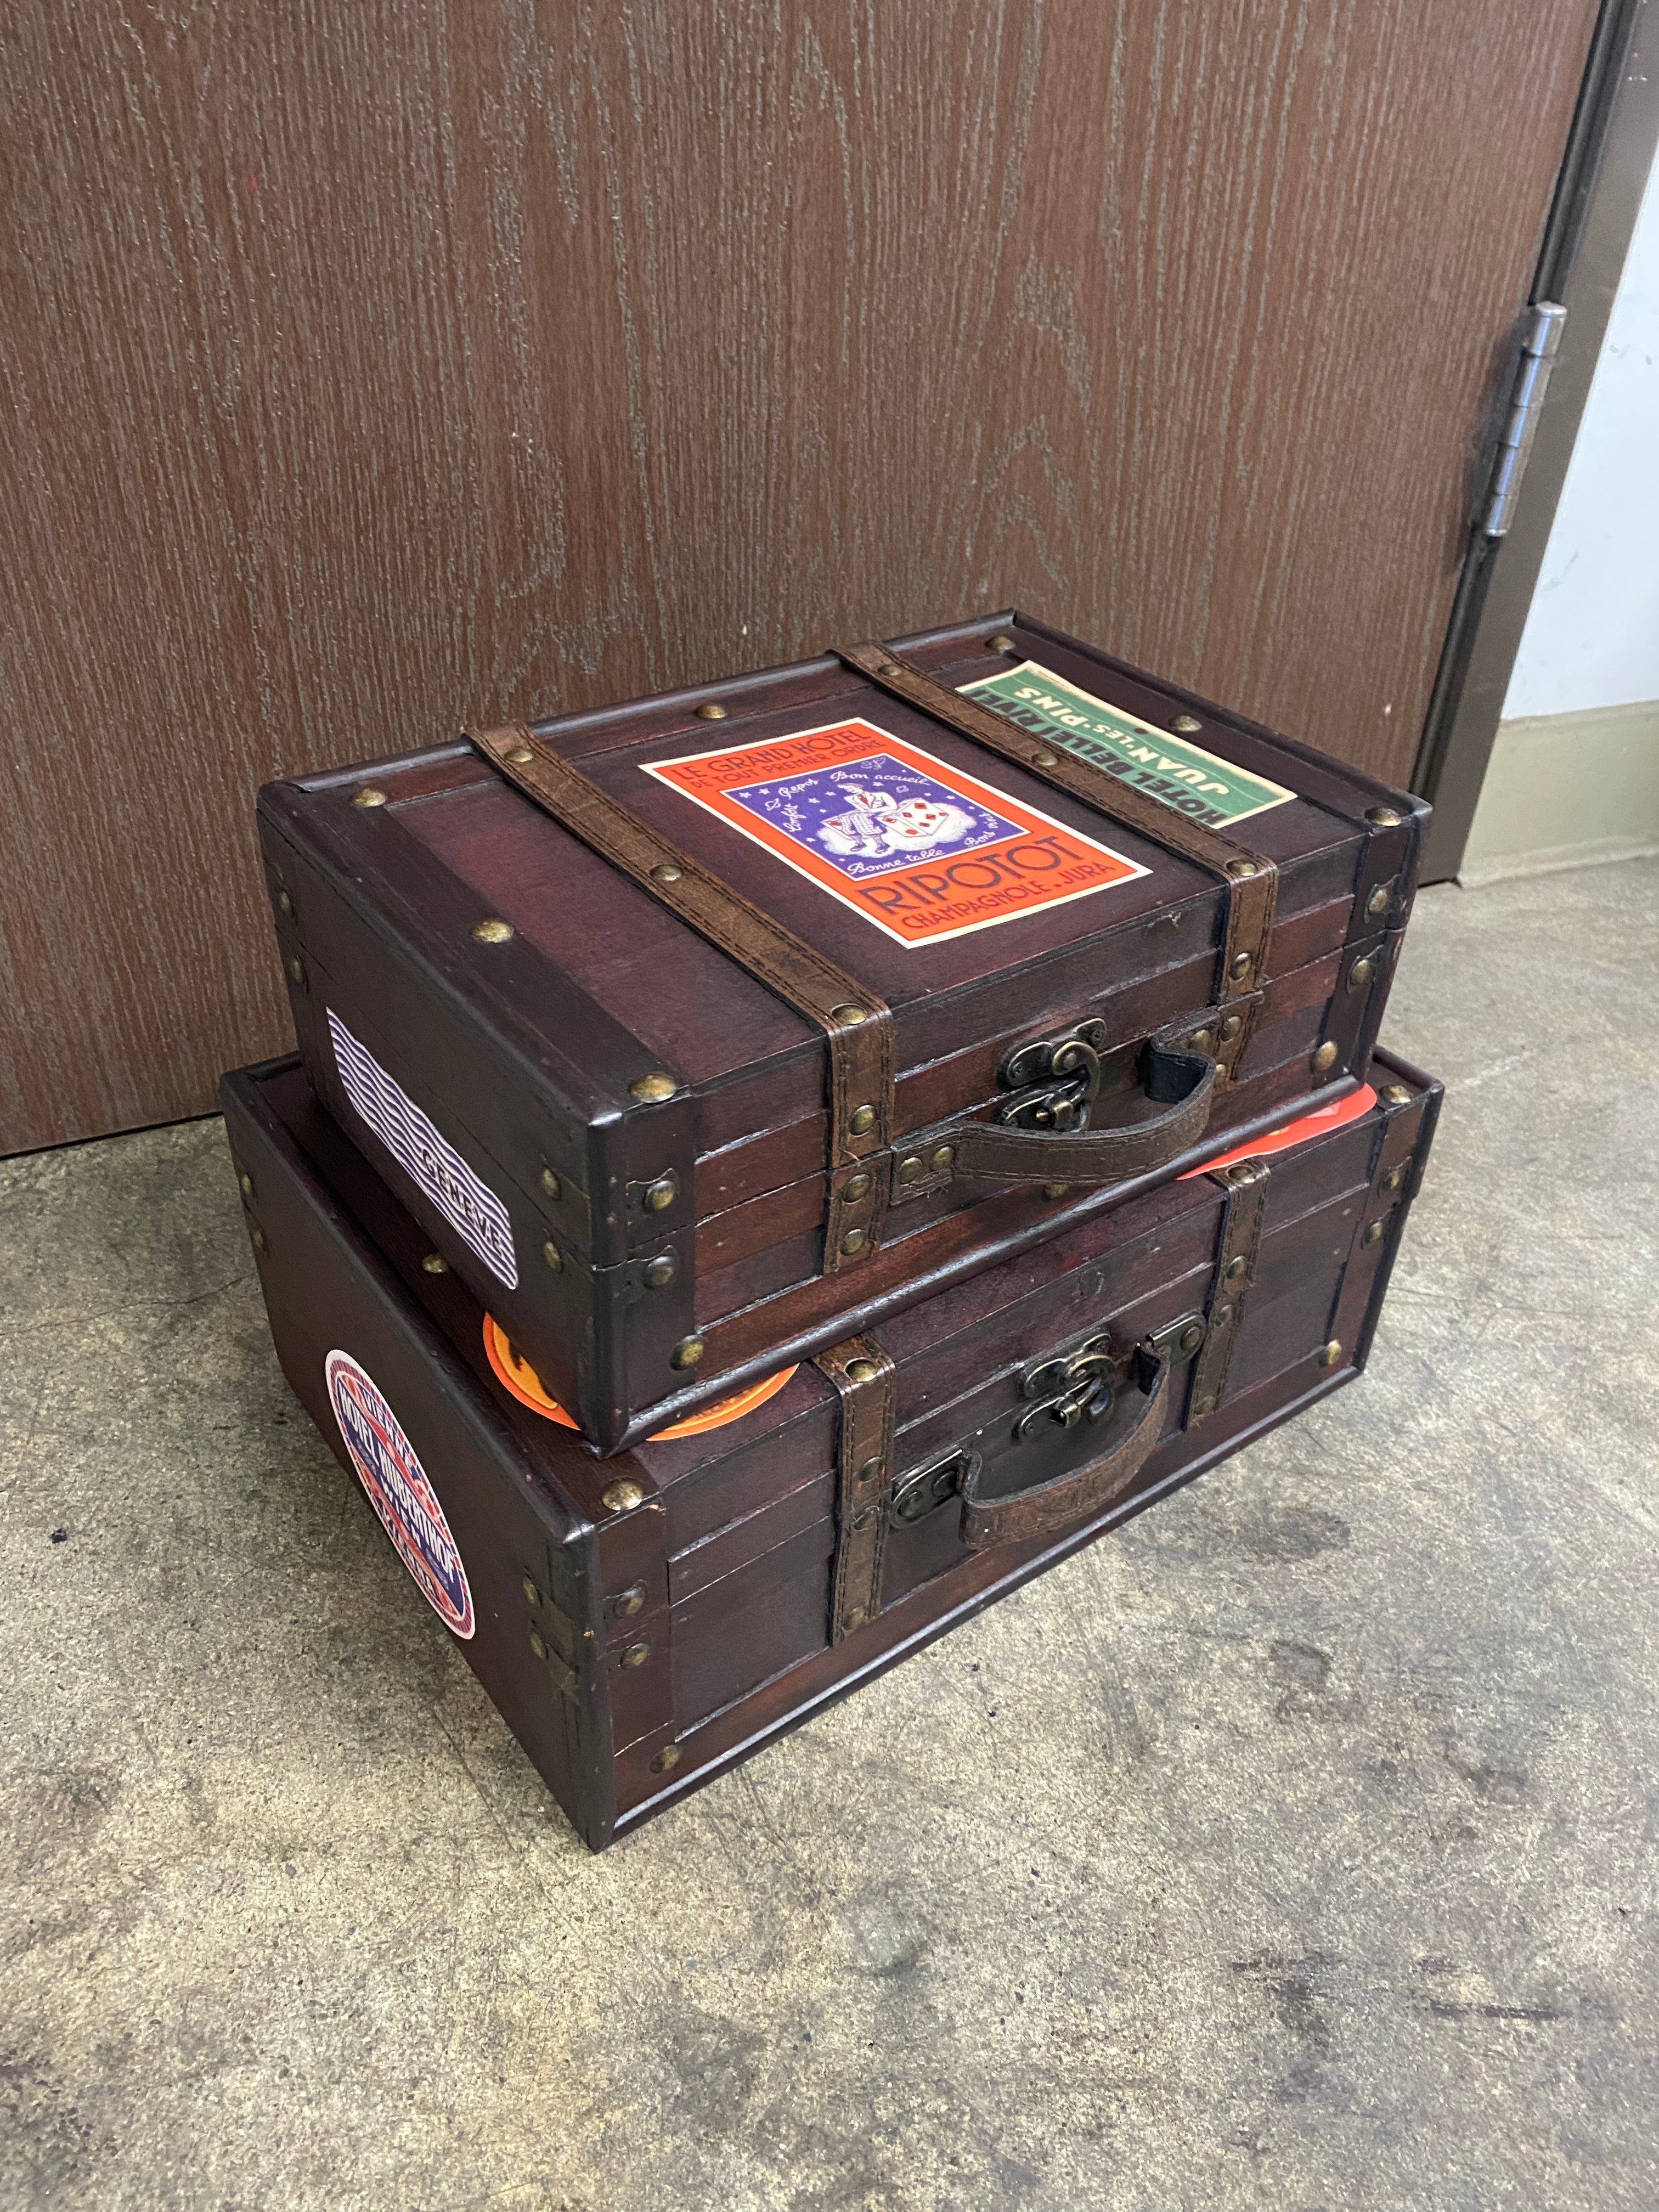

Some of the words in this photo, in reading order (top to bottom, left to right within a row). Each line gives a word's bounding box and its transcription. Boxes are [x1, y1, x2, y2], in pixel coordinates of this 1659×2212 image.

[672, 765, 707, 780] LE
[708, 747, 792, 772] GRAND
[690, 778, 713, 788] DE
[712, 768, 759, 784] TOUT
[761, 753, 829, 774] PREMIER
[831, 740, 885, 757] ORDRE
[830, 771, 870, 782] Bon
[874, 774, 932, 786] accueil
[1132, 772, 1227, 824] HOTEL
[847, 861, 906, 875] Bonne
[905, 849, 946, 862] table
[857, 836, 1084, 915] RIPOTOT
[902, 881, 1051, 929] CHAMPAGNOLE
[1058, 861, 1116, 885] JURA
[421, 1148, 505, 1257] GENEVE
[362, 1387, 412, 1475] VIENNE
[338, 1380, 380, 1466] HOTEL
[377, 1441, 454, 1584] HUBERTHOF
[380, 1474, 422, 1549] WIEN
